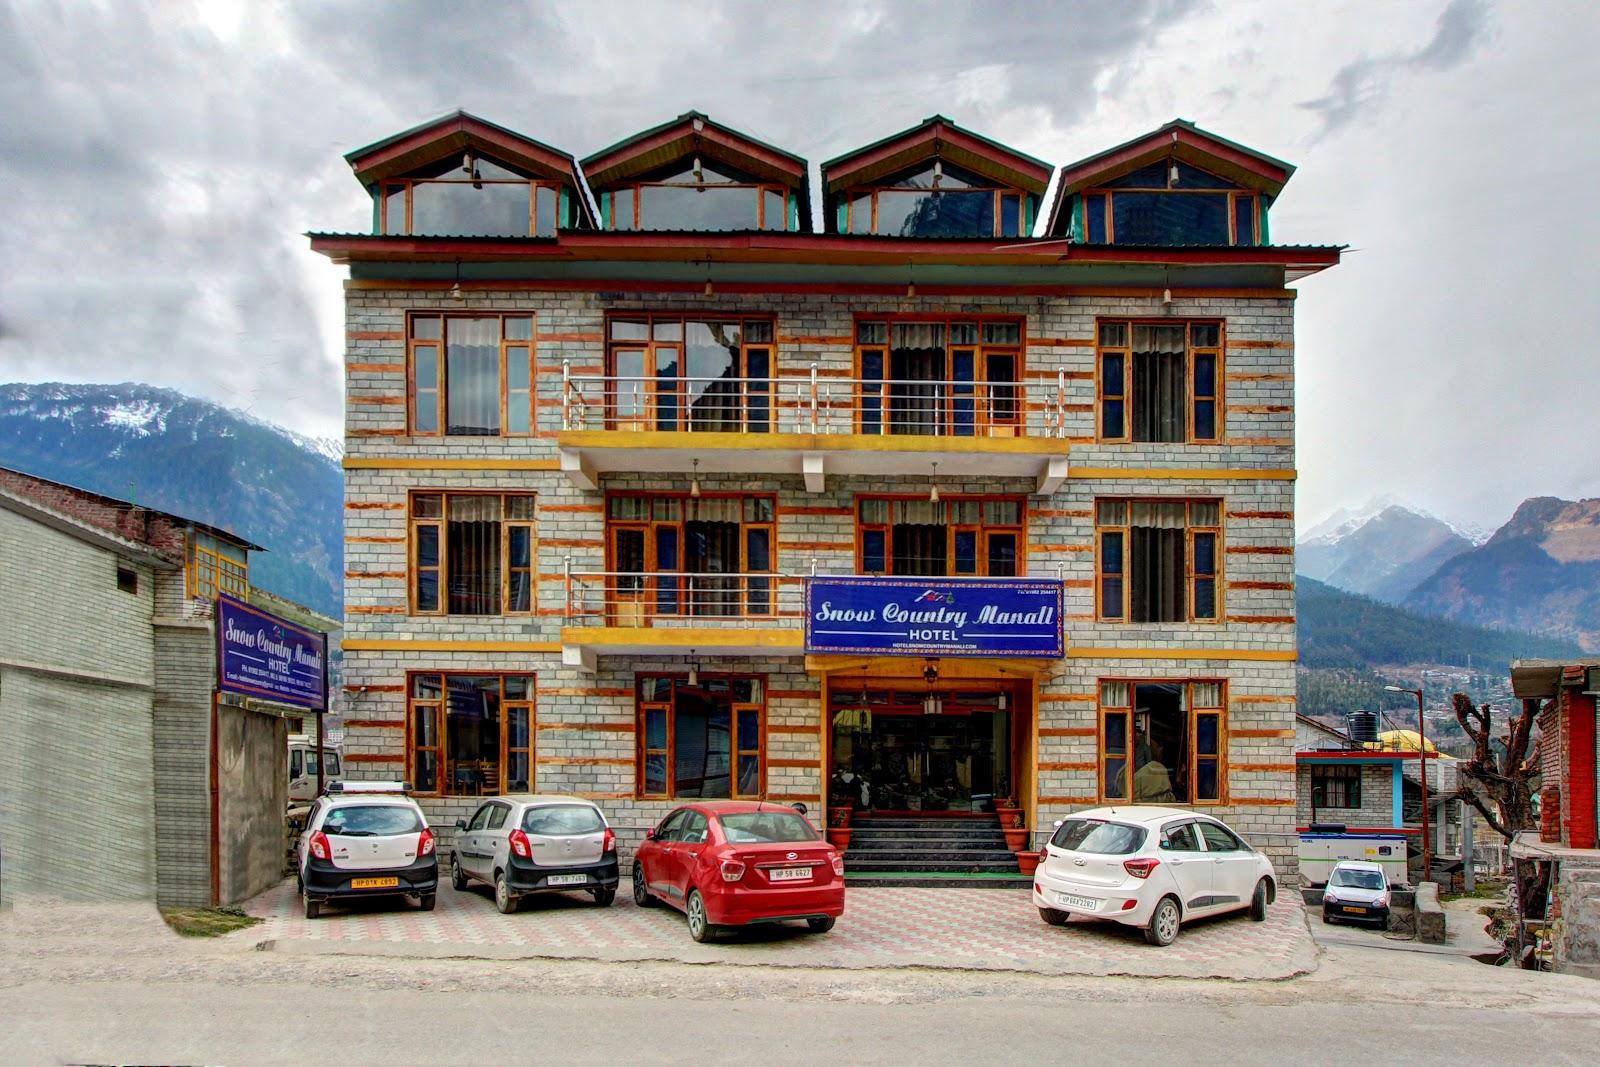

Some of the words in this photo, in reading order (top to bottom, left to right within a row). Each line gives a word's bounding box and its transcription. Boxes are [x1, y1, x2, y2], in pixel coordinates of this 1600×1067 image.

[815, 601, 876, 622] Snow
[882, 603, 968, 628] Country
[225, 618, 256, 648] Snow
[257, 628, 292, 664] Country
[293, 643, 321, 670] Manali
[909, 629, 959, 641] HOTEL
[268, 657, 290, 675] HOTEL
